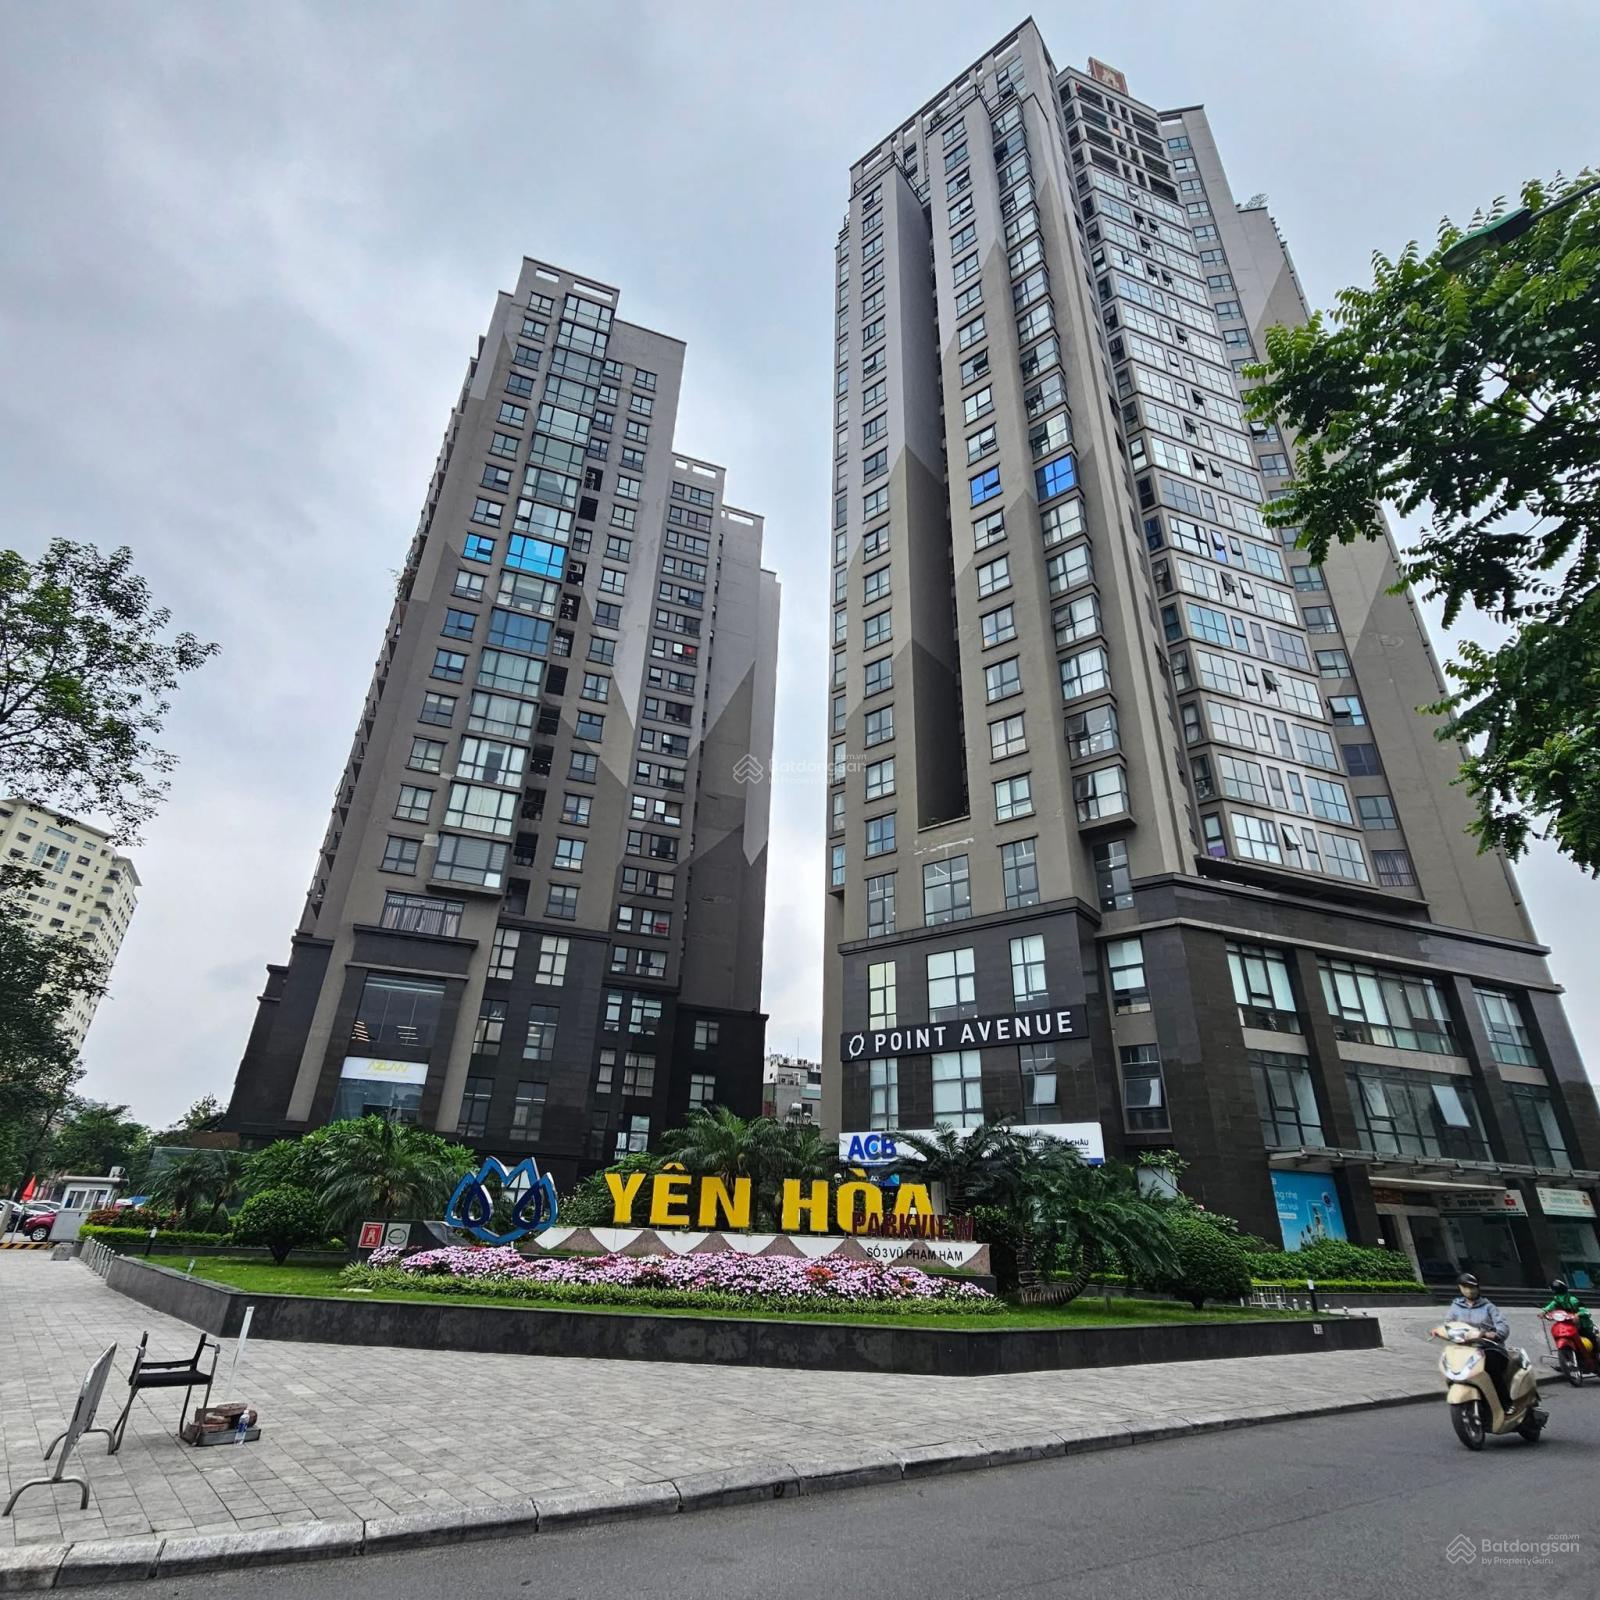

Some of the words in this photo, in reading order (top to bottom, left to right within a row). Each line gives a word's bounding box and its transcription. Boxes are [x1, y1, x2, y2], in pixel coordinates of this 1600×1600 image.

[875, 1026, 947, 1052] POINT
[960, 1011, 1073, 1043] AVENUE
[847, 1134, 897, 1161] ACB
[604, 1162, 751, 1228] YÊN
[781, 1168, 935, 1237] HÒA
[852, 1213, 974, 1240] PARKVIEW
[866, 1243, 881, 1258] SỐ
[882, 1248, 888, 1258] 3
[890, 1246, 904, 1258] VŨ
[905, 1248, 937, 1262] PHẠM
[939, 1247, 963, 1262] HÀM
